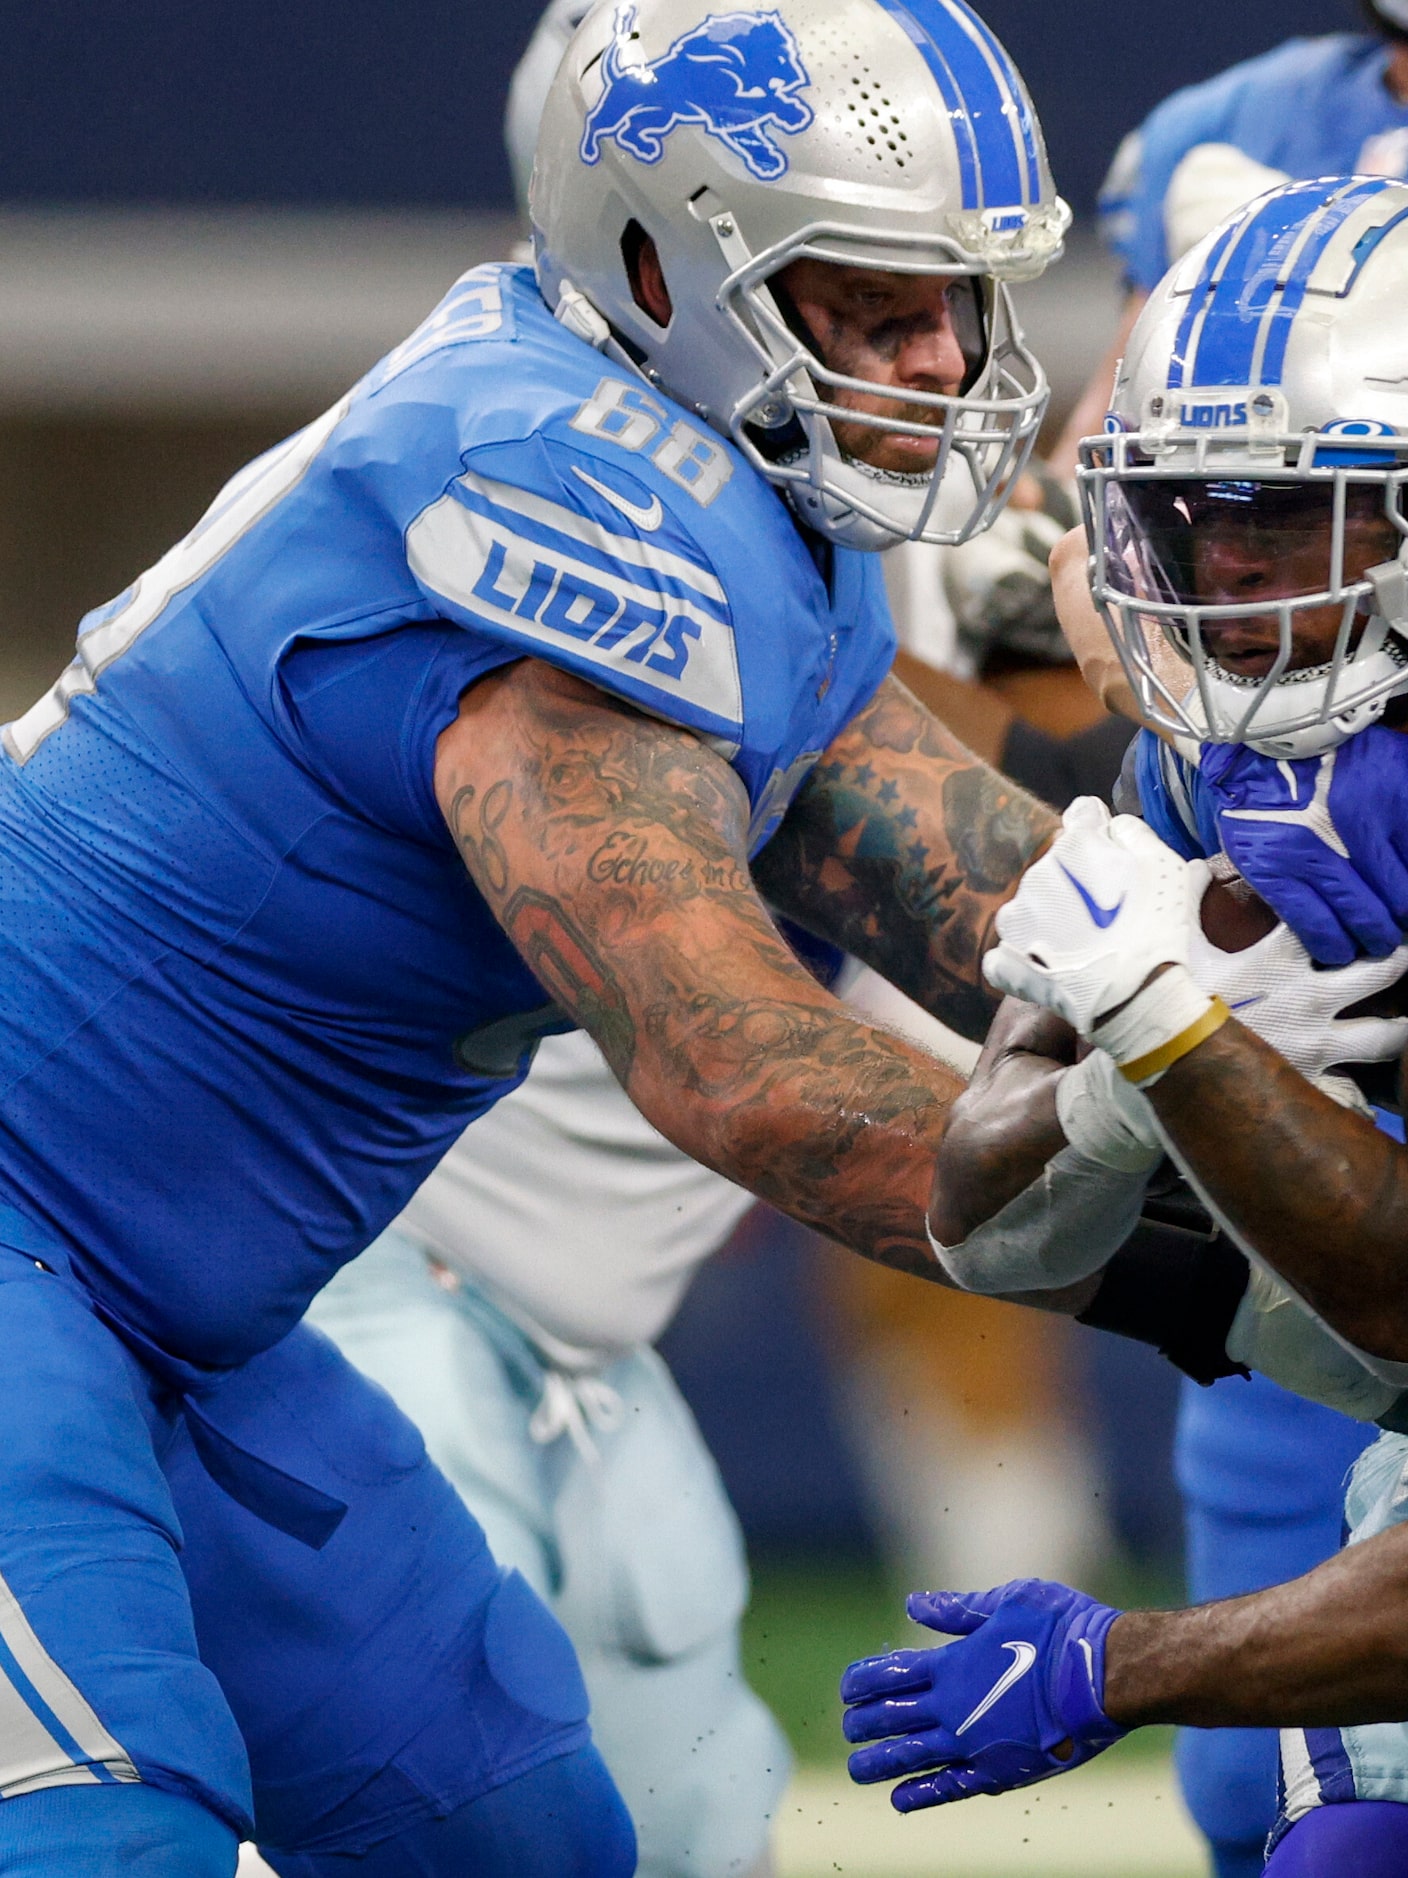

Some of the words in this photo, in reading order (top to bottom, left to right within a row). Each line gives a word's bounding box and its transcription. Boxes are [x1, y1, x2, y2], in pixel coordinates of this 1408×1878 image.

[568, 376, 735, 509] 68
[1181, 402, 1247, 427] LIONS
[471, 539, 702, 681] LIONS
